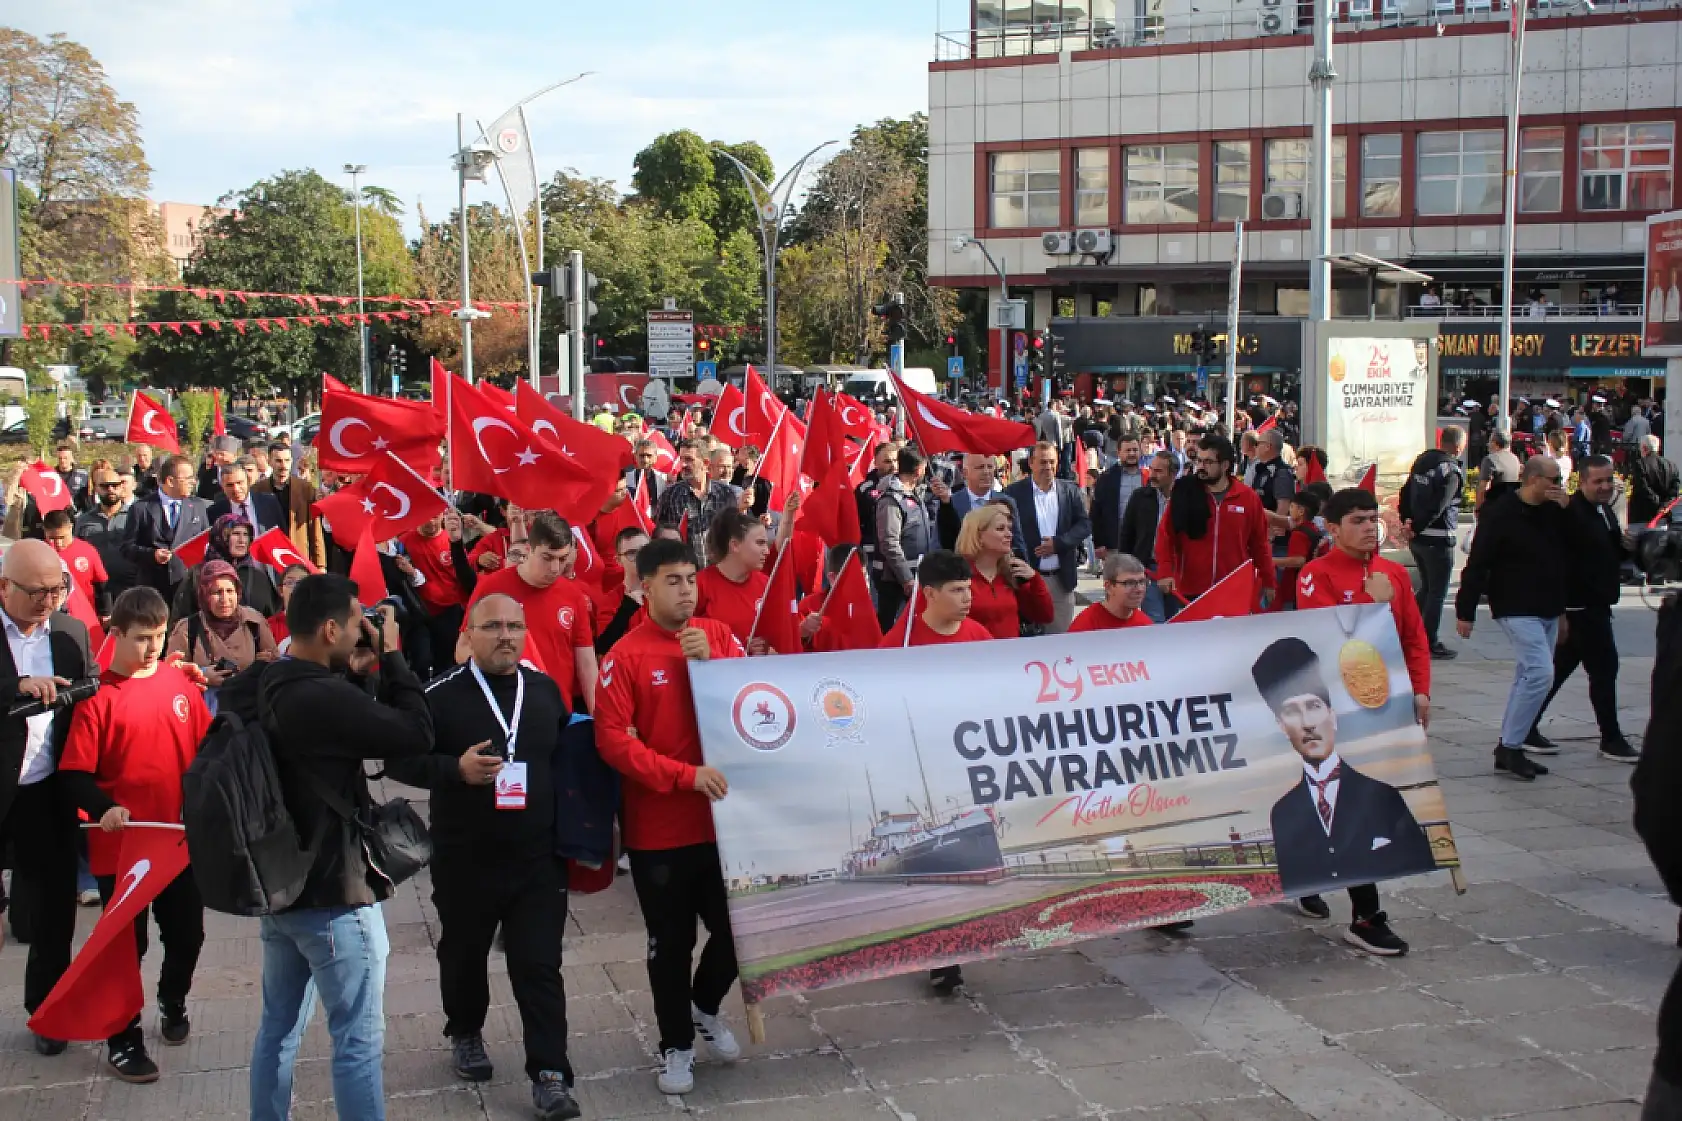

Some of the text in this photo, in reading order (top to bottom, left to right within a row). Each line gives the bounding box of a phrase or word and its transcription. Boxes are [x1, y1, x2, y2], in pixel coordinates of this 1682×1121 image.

[1174, 333, 1259, 355] MTO
[1024, 657, 1085, 703] 29
[953, 693, 1232, 760] CUMHURİYET
[967, 733, 1247, 805] BAYRAMIMIZ
[1036, 783, 1190, 827] Kutlu Olsun
